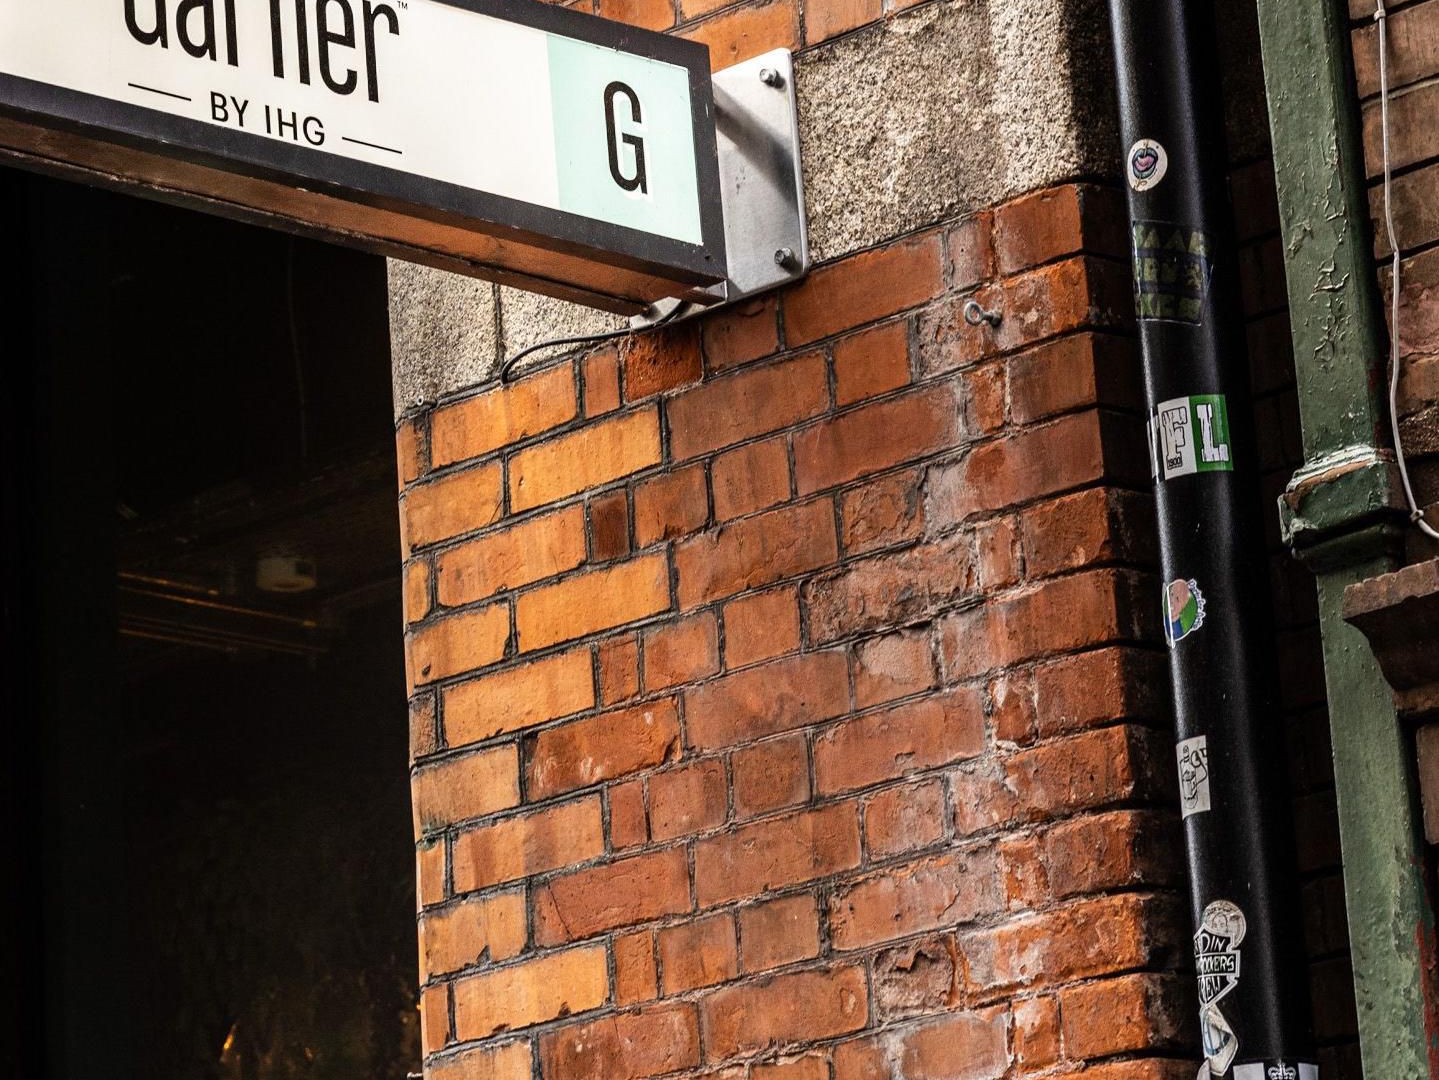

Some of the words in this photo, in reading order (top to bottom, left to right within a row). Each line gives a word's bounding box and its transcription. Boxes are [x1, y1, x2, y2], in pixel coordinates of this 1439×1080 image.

[210, 91, 249, 127] BY
[265, 105, 325, 146] IHG
[604, 81, 648, 195] G
